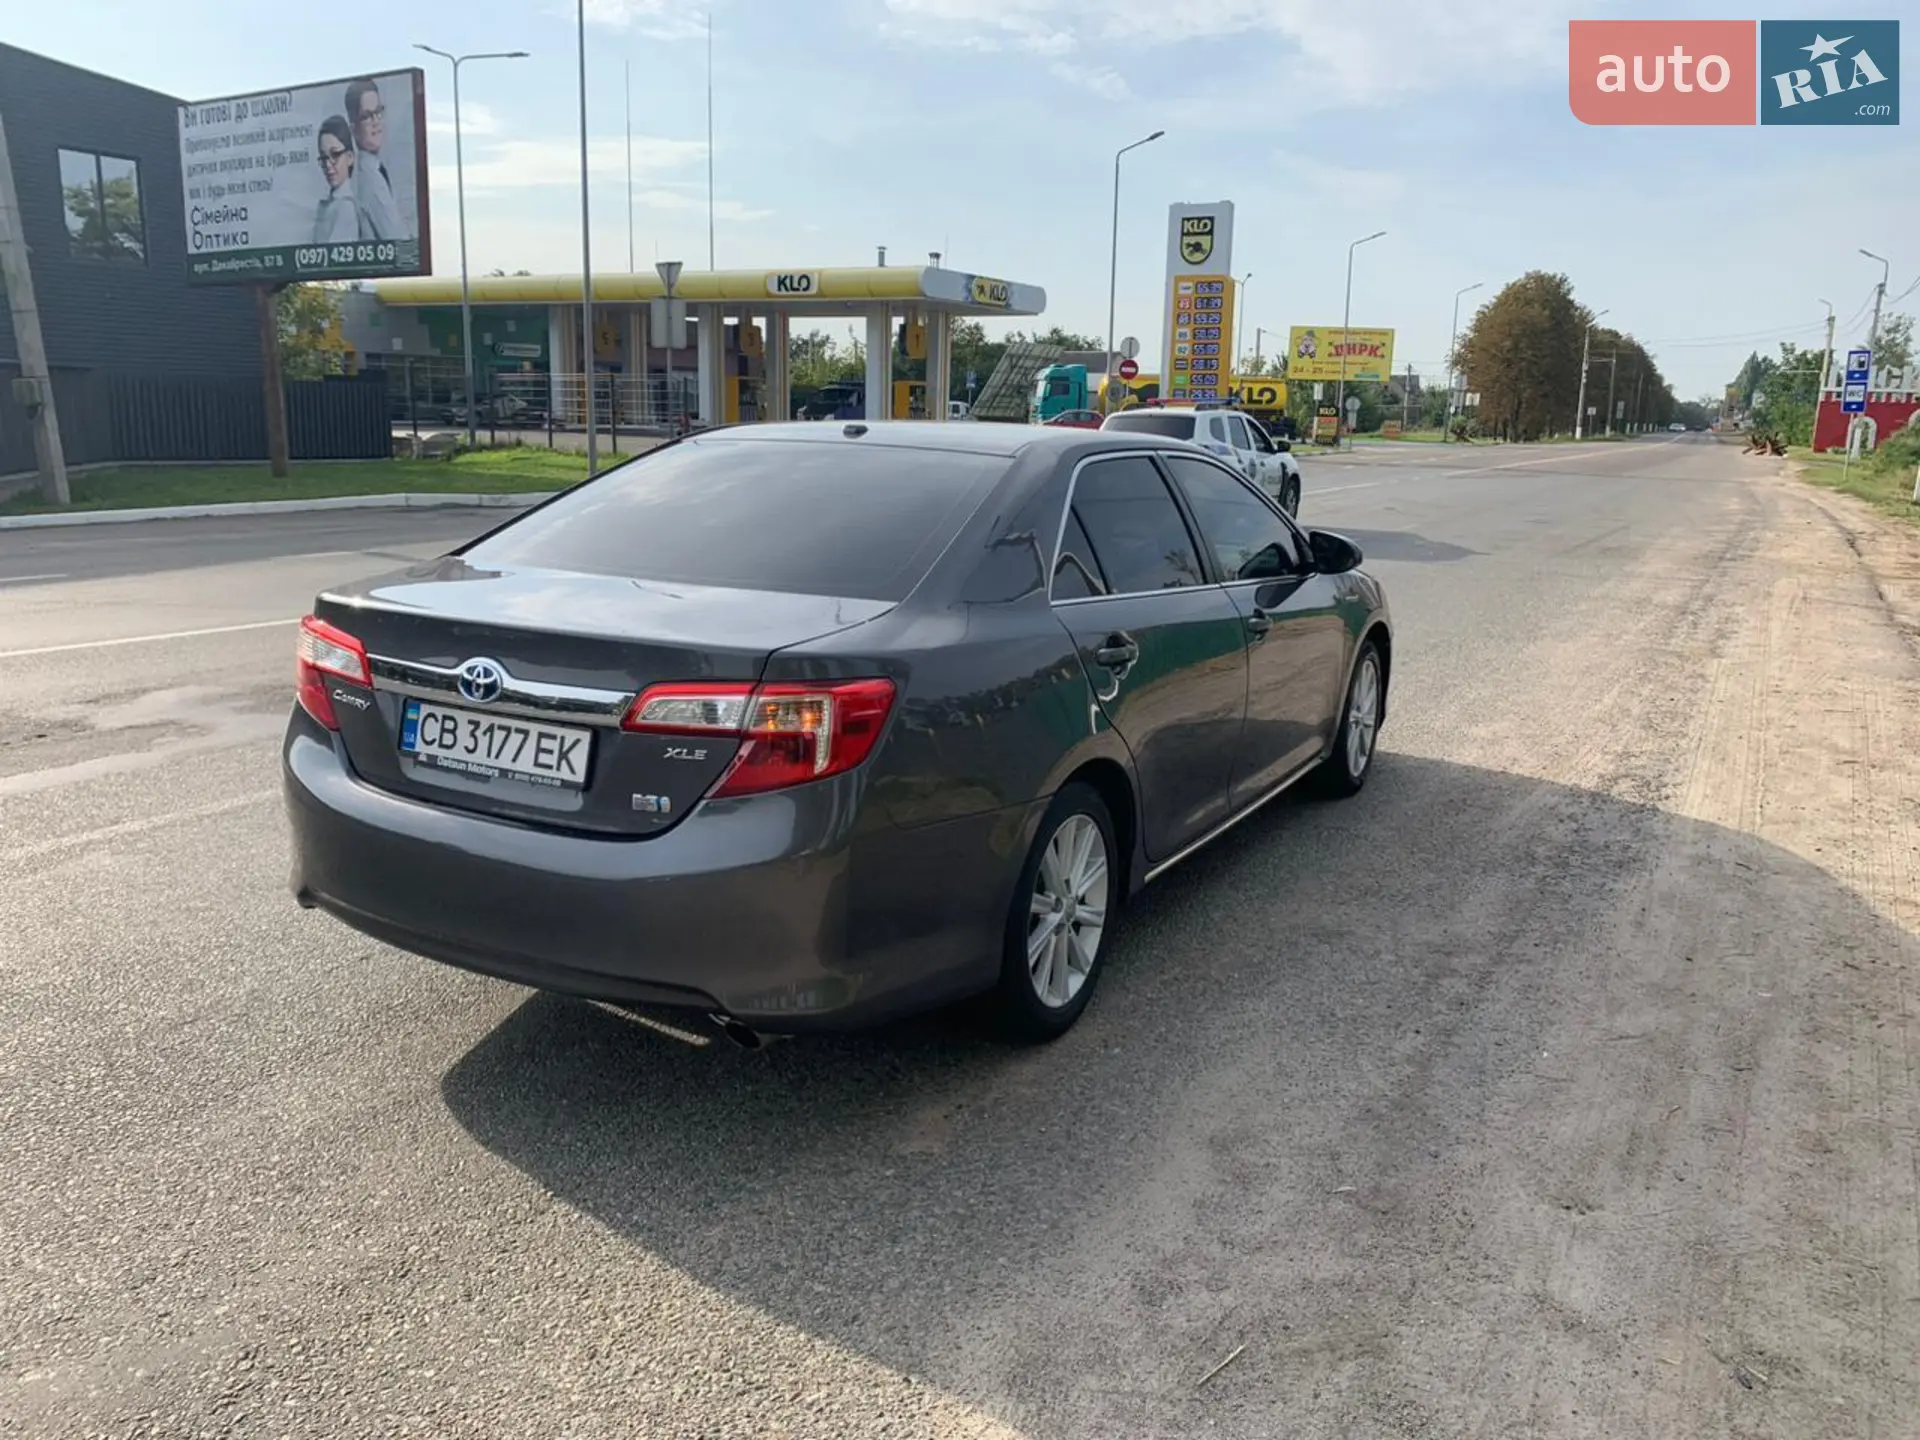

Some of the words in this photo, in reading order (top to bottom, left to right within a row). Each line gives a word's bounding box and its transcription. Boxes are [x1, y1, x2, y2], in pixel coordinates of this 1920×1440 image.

[191, 204, 248, 227] Сімейна
[1183, 219, 1212, 234] KLO
[192, 230, 250, 251] Оптика
[295, 248, 328, 268] (097)
[331, 246, 354, 263] 429
[357, 245, 374, 261] 05
[377, 244, 395, 260] 09
[777, 274, 811, 292] KLO
[989, 283, 1008, 300] KLO
[1847, 389, 1865, 398] WC
[1319, 407, 1337, 416] KLO
[420, 711, 458, 750] CB
[464, 718, 530, 763] 3177
[533, 731, 582, 775] EK
[663, 747, 708, 760] XLE
[468, 762, 500, 777] Motors
